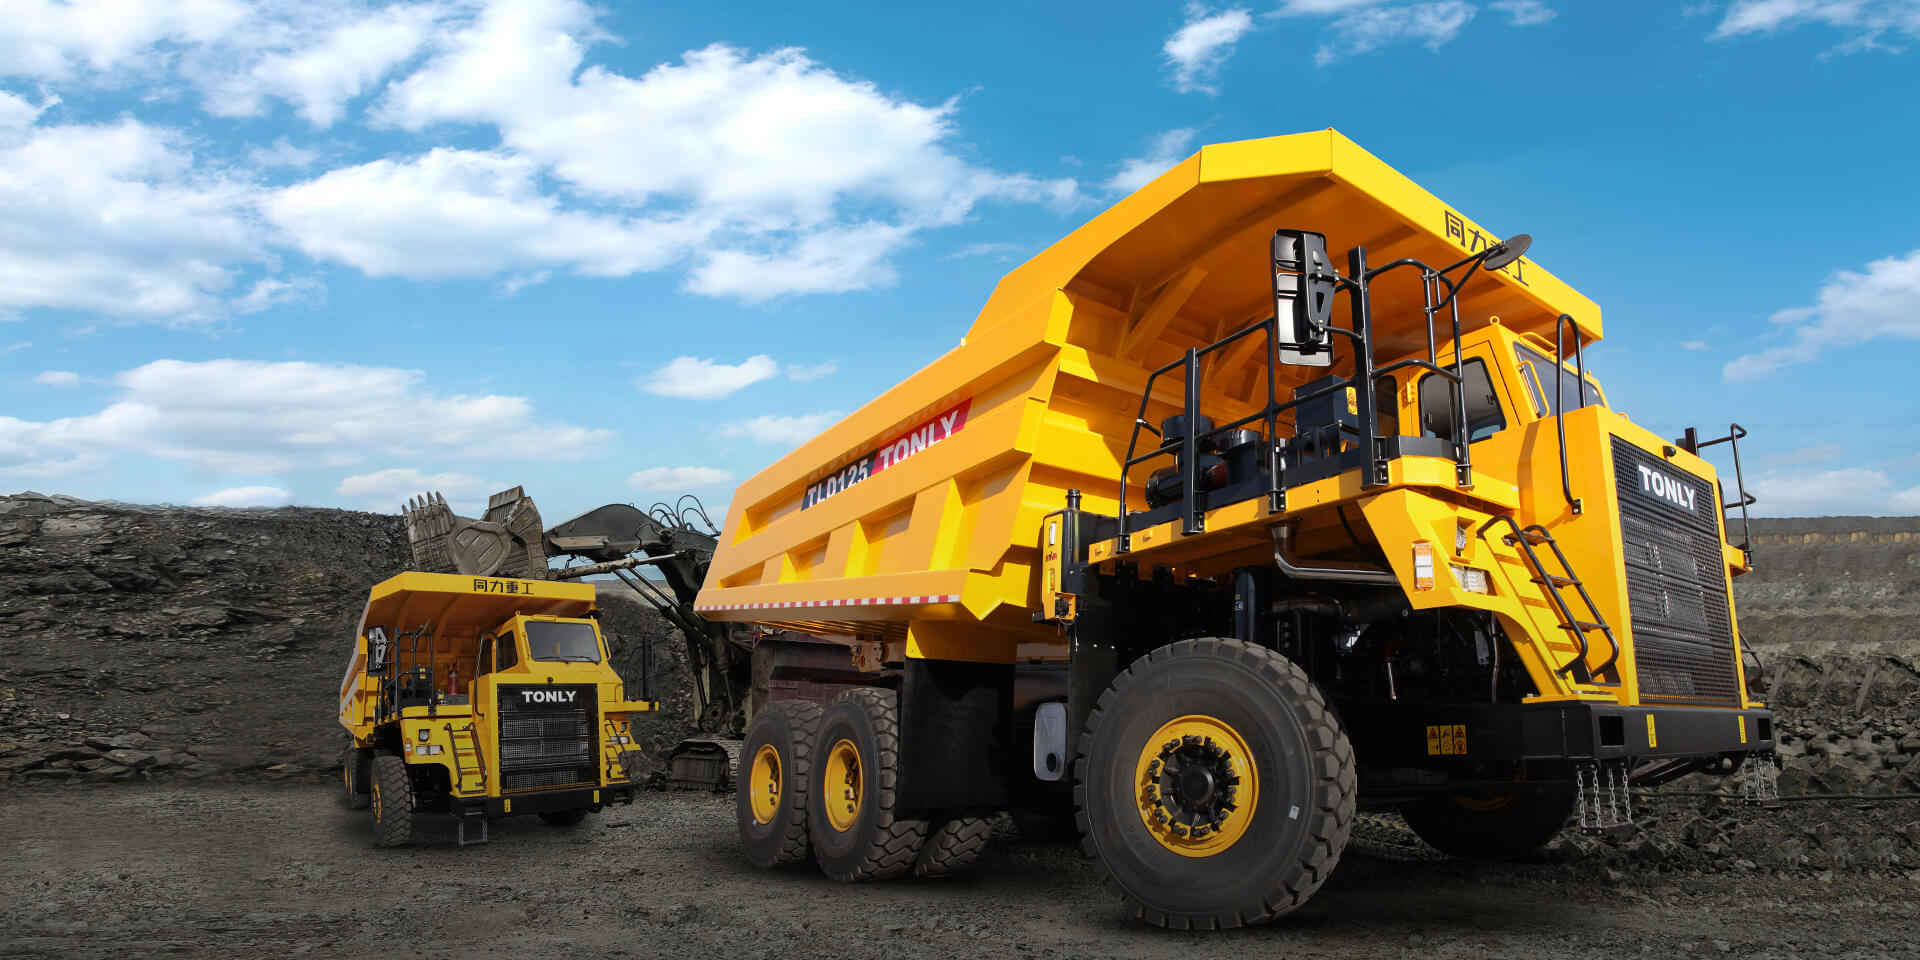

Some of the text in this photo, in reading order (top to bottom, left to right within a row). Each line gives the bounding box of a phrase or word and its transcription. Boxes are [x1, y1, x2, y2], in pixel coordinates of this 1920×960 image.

[1444, 209, 1530, 288] 同力工
[807, 409, 959, 508] TLD125 TONLY
[1638, 464, 1695, 511] TONLY
[473, 578, 535, 595] 同力重工
[521, 690, 577, 703] TONLY
